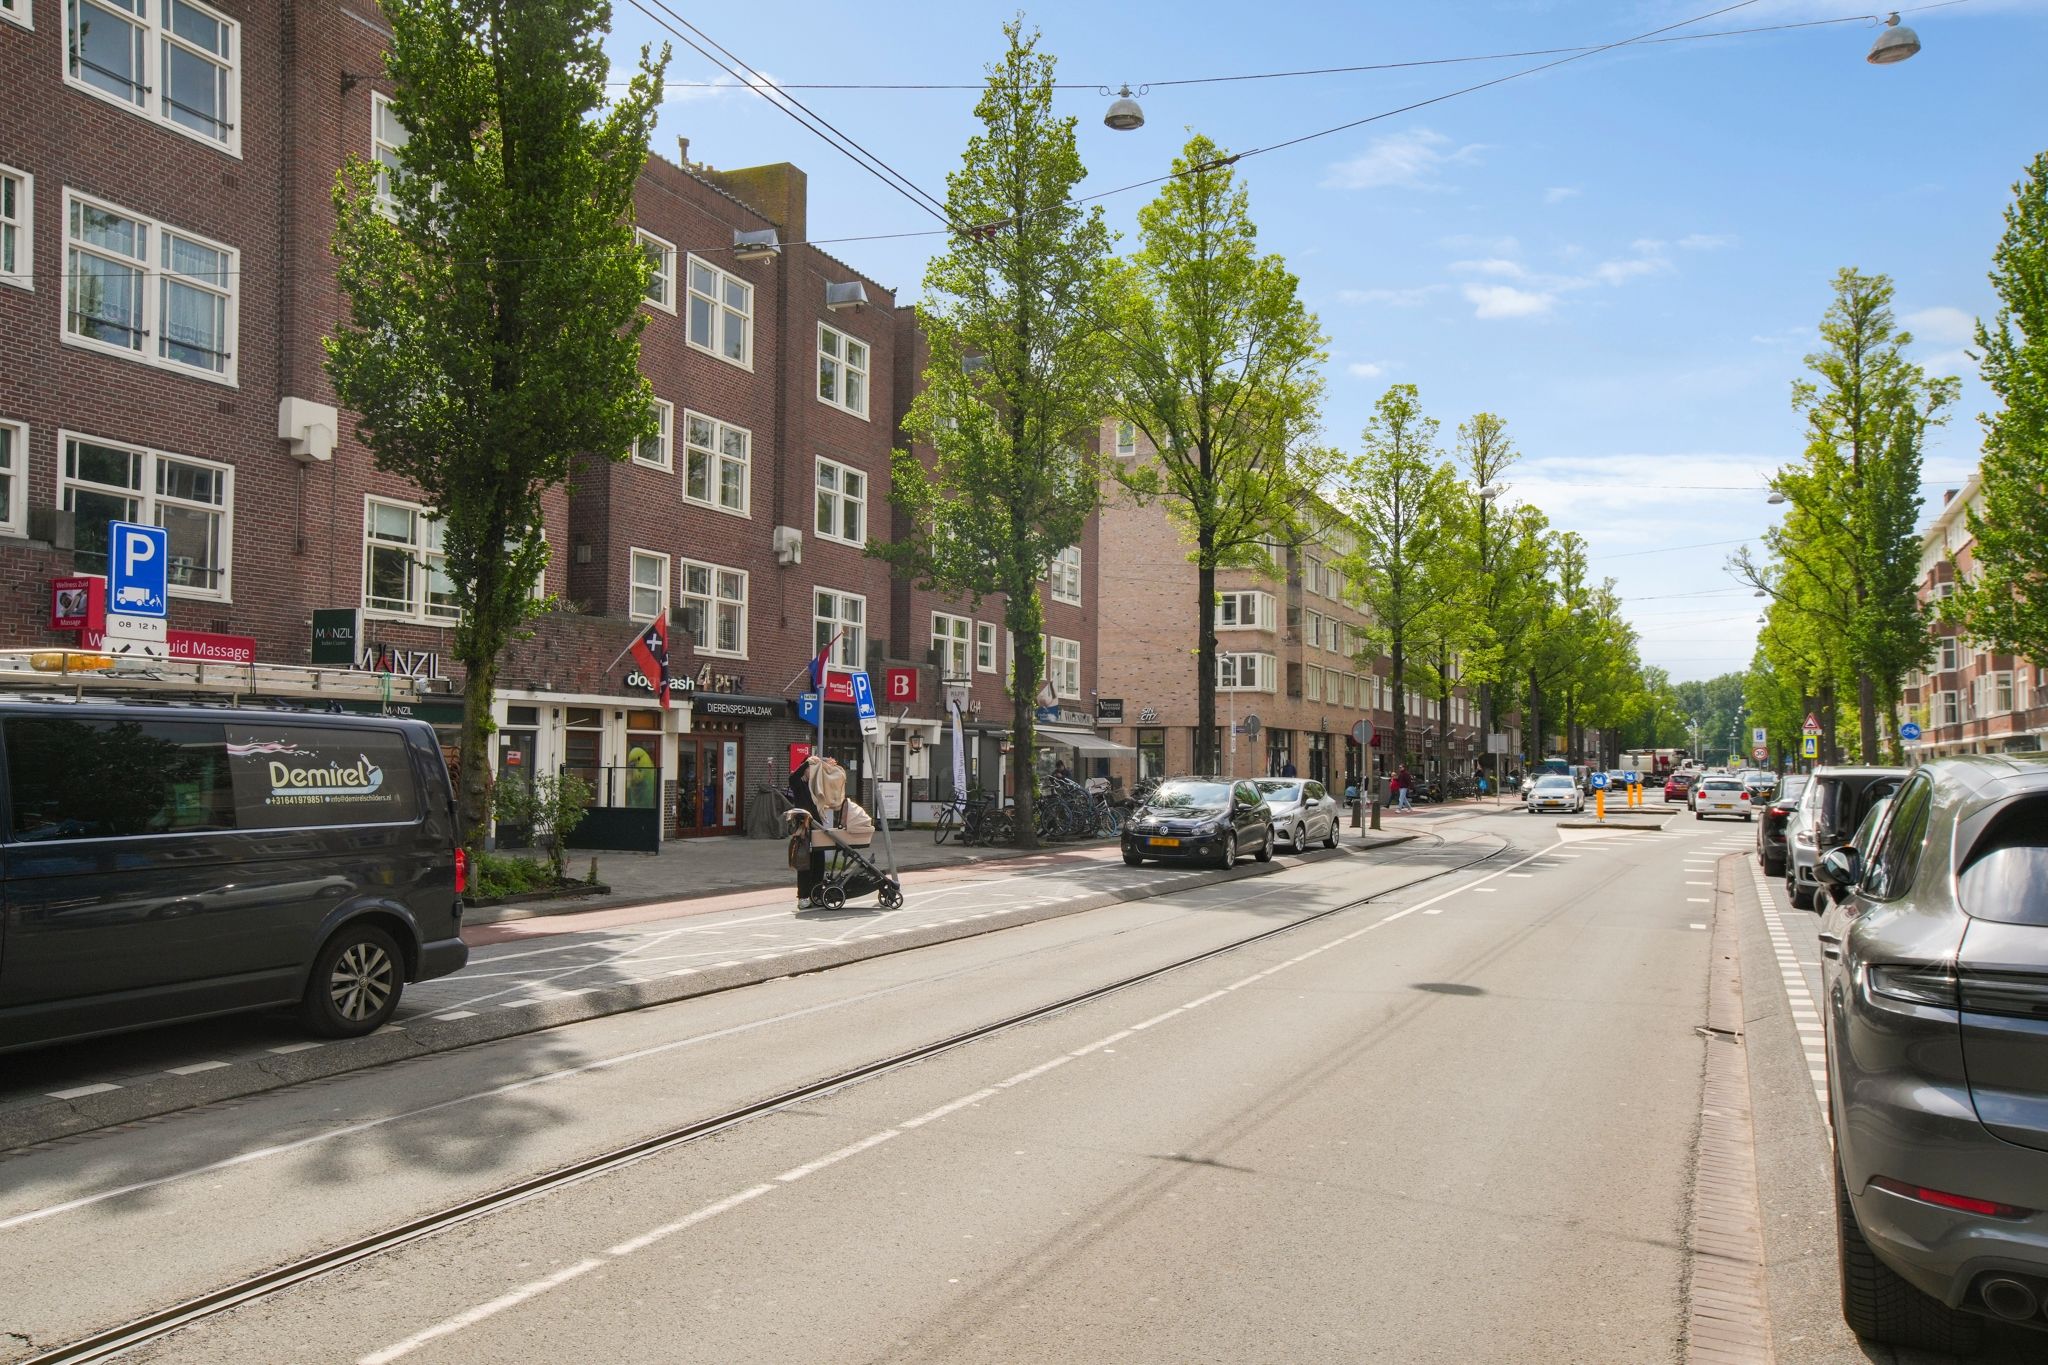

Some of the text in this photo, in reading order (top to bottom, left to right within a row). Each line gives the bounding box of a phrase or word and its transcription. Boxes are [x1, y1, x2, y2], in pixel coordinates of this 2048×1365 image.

[126, 532, 155, 577] P
[56, 580, 89, 589] Wellness Zuid
[60, 619, 81, 627] Massage
[192, 641, 250, 661] Massage
[856, 676, 867, 699] P
[707, 703, 773, 717] DIERENSPECIAALZAAK
[804, 702, 813, 714] P
[269, 760, 368, 788] Demirel
